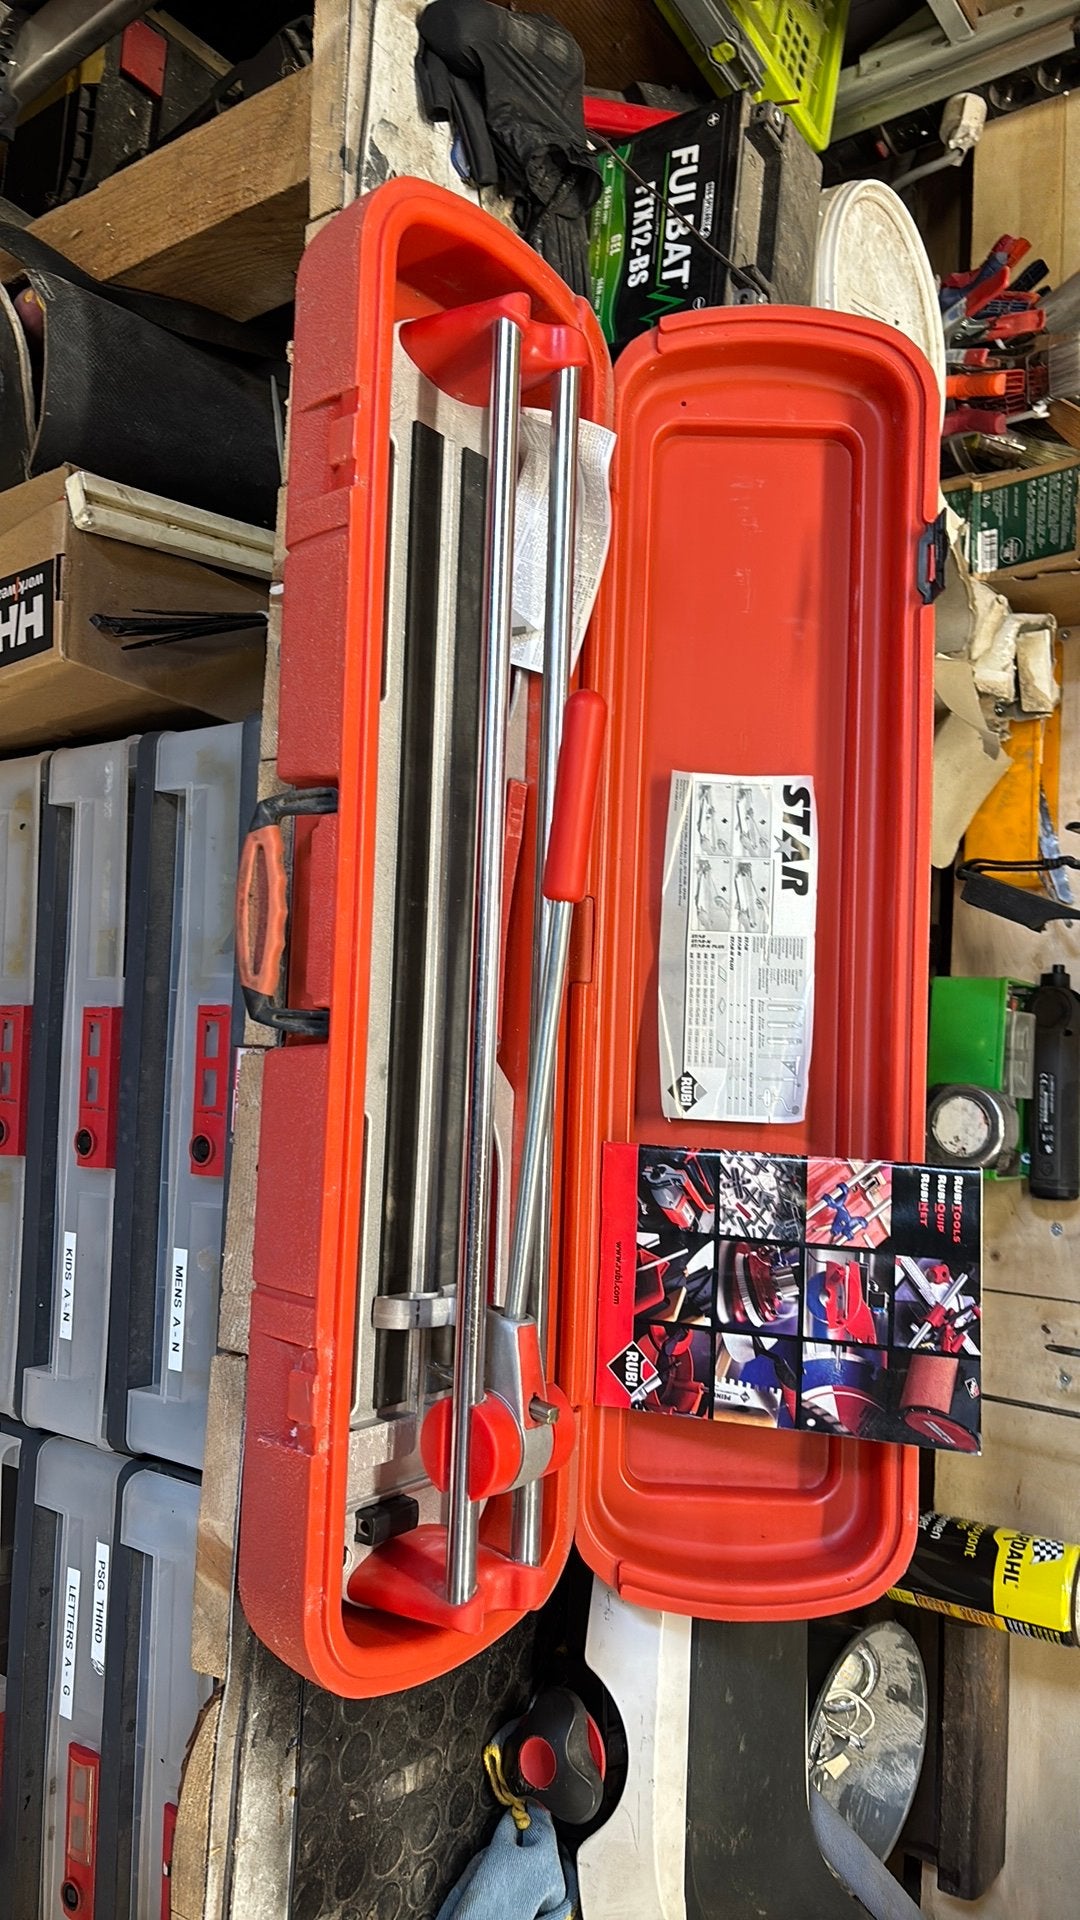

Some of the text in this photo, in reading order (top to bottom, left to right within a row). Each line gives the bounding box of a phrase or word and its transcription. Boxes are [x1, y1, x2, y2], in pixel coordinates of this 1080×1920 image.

[661, 144, 700, 283] FULBAT
[609, 233, 623, 256] GEL
[781, 785, 811, 896] STAR
[681, 1076, 693, 1107] RUBI
[64, 1248, 73, 1281] KIDS
[613, 1241, 623, 1305] www.rubi.com
[63, 1288, 71, 1299] A
[173, 1265, 184, 1308] MENS
[62, 1312, 70, 1322] N
[172, 1316, 180, 1328] A
[171, 1341, 179, 1353] N
[625, 1351, 639, 1388] RUBI
[1003, 1535, 1030, 1585] RDAHL
[65, 1585, 77, 1650] LETTERS
[94, 1560, 106, 1644] PSG THIRD
[64, 1657, 72, 1667] A
[62, 1684, 70, 1697] G
